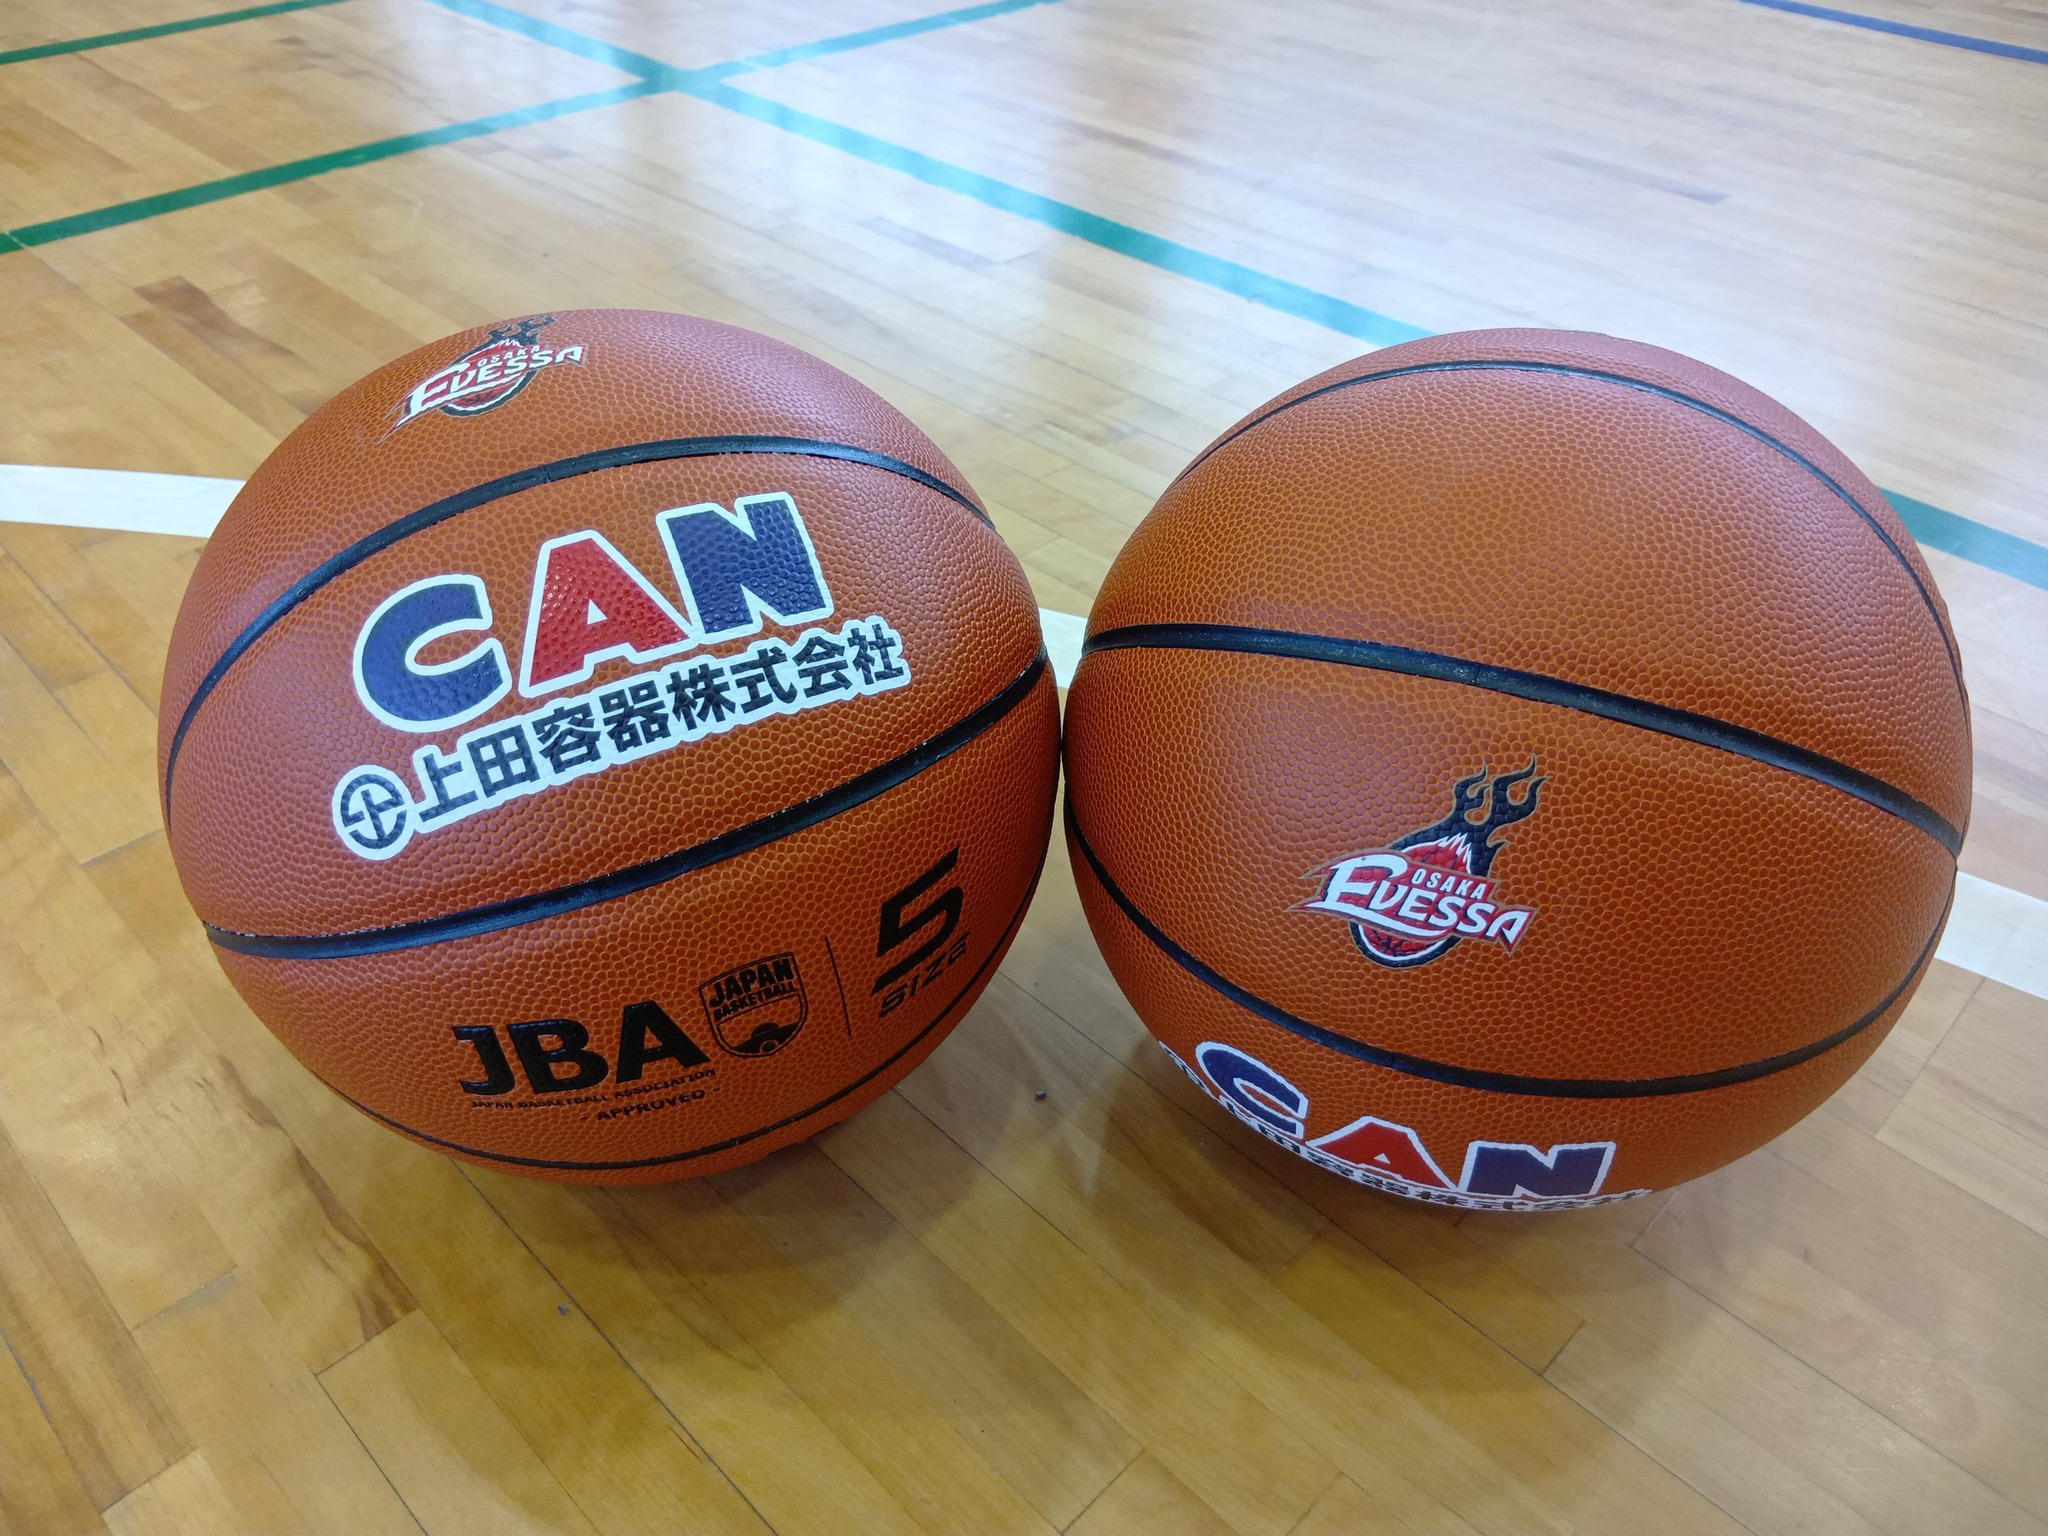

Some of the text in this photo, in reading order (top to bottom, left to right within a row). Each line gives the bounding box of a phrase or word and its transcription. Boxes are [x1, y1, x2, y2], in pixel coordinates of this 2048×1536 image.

[476, 345, 541, 368] OSAKA
[356, 494, 831, 729] CAN
[417, 621, 905, 824] 上田容器株式会社
[871, 846, 964, 997] 5
[1304, 854, 1530, 946] EVESSA
[1410, 869, 1487, 900] OSAKA
[709, 958, 794, 1008] JAPAN
[713, 980, 796, 1021] BASKETBALL
[879, 931, 971, 1018] SIZE
[452, 1000, 711, 1096] JBA
[471, 1068, 716, 1109] JAPAN BASKETBALL ASSOCIATION
[1198, 1044, 1613, 1197] CAN
